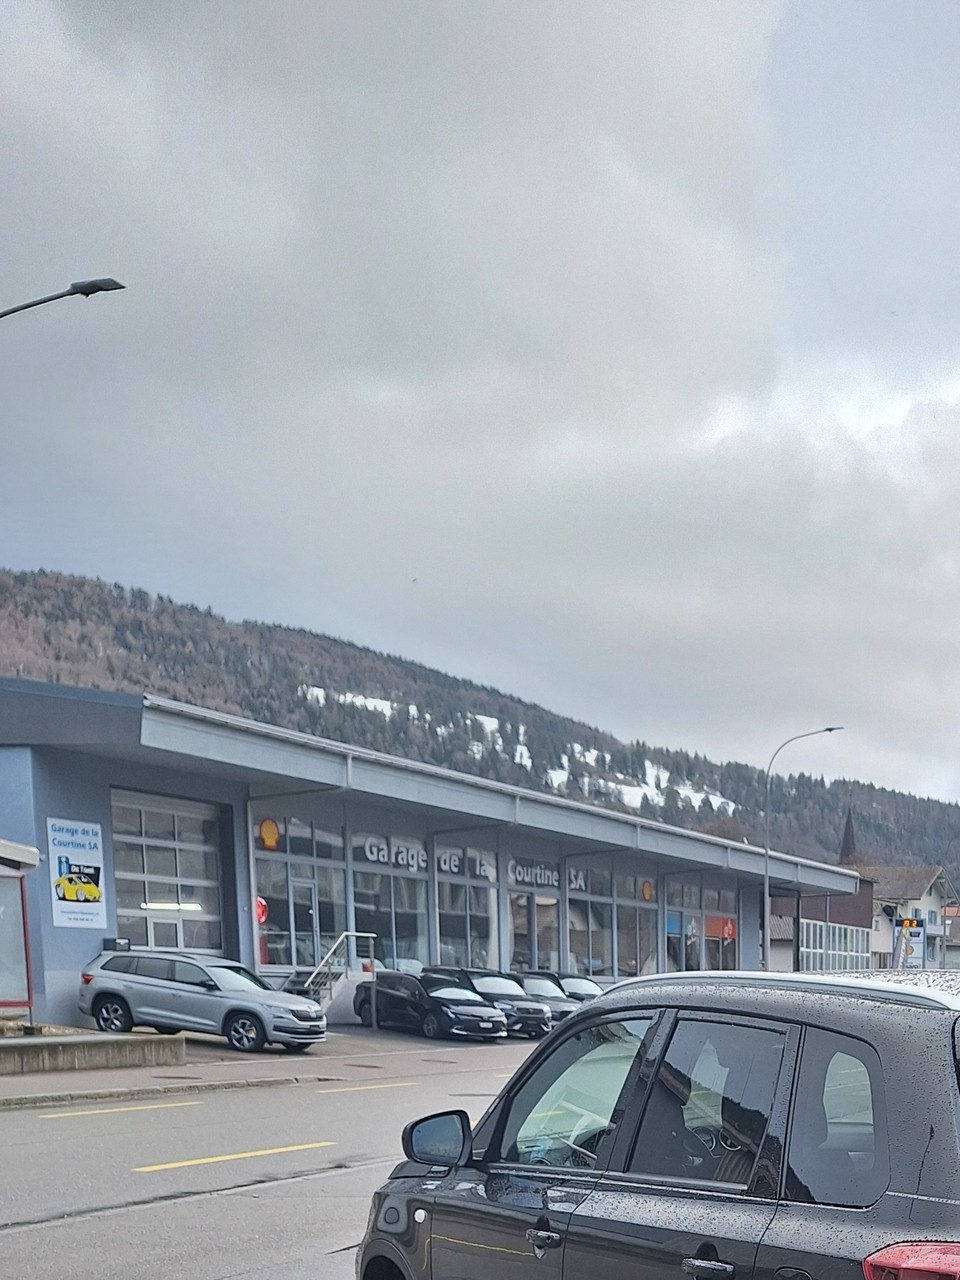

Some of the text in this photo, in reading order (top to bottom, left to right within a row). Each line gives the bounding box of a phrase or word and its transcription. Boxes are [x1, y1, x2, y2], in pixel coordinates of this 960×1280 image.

[51, 823, 99, 837] Garage de la
[51, 838, 99, 851] Courtine SA
[364, 836, 428, 873] Garage
[440, 851, 459, 873] de
[507, 859, 560, 887] Courtine
[570, 867, 586, 892] SA
